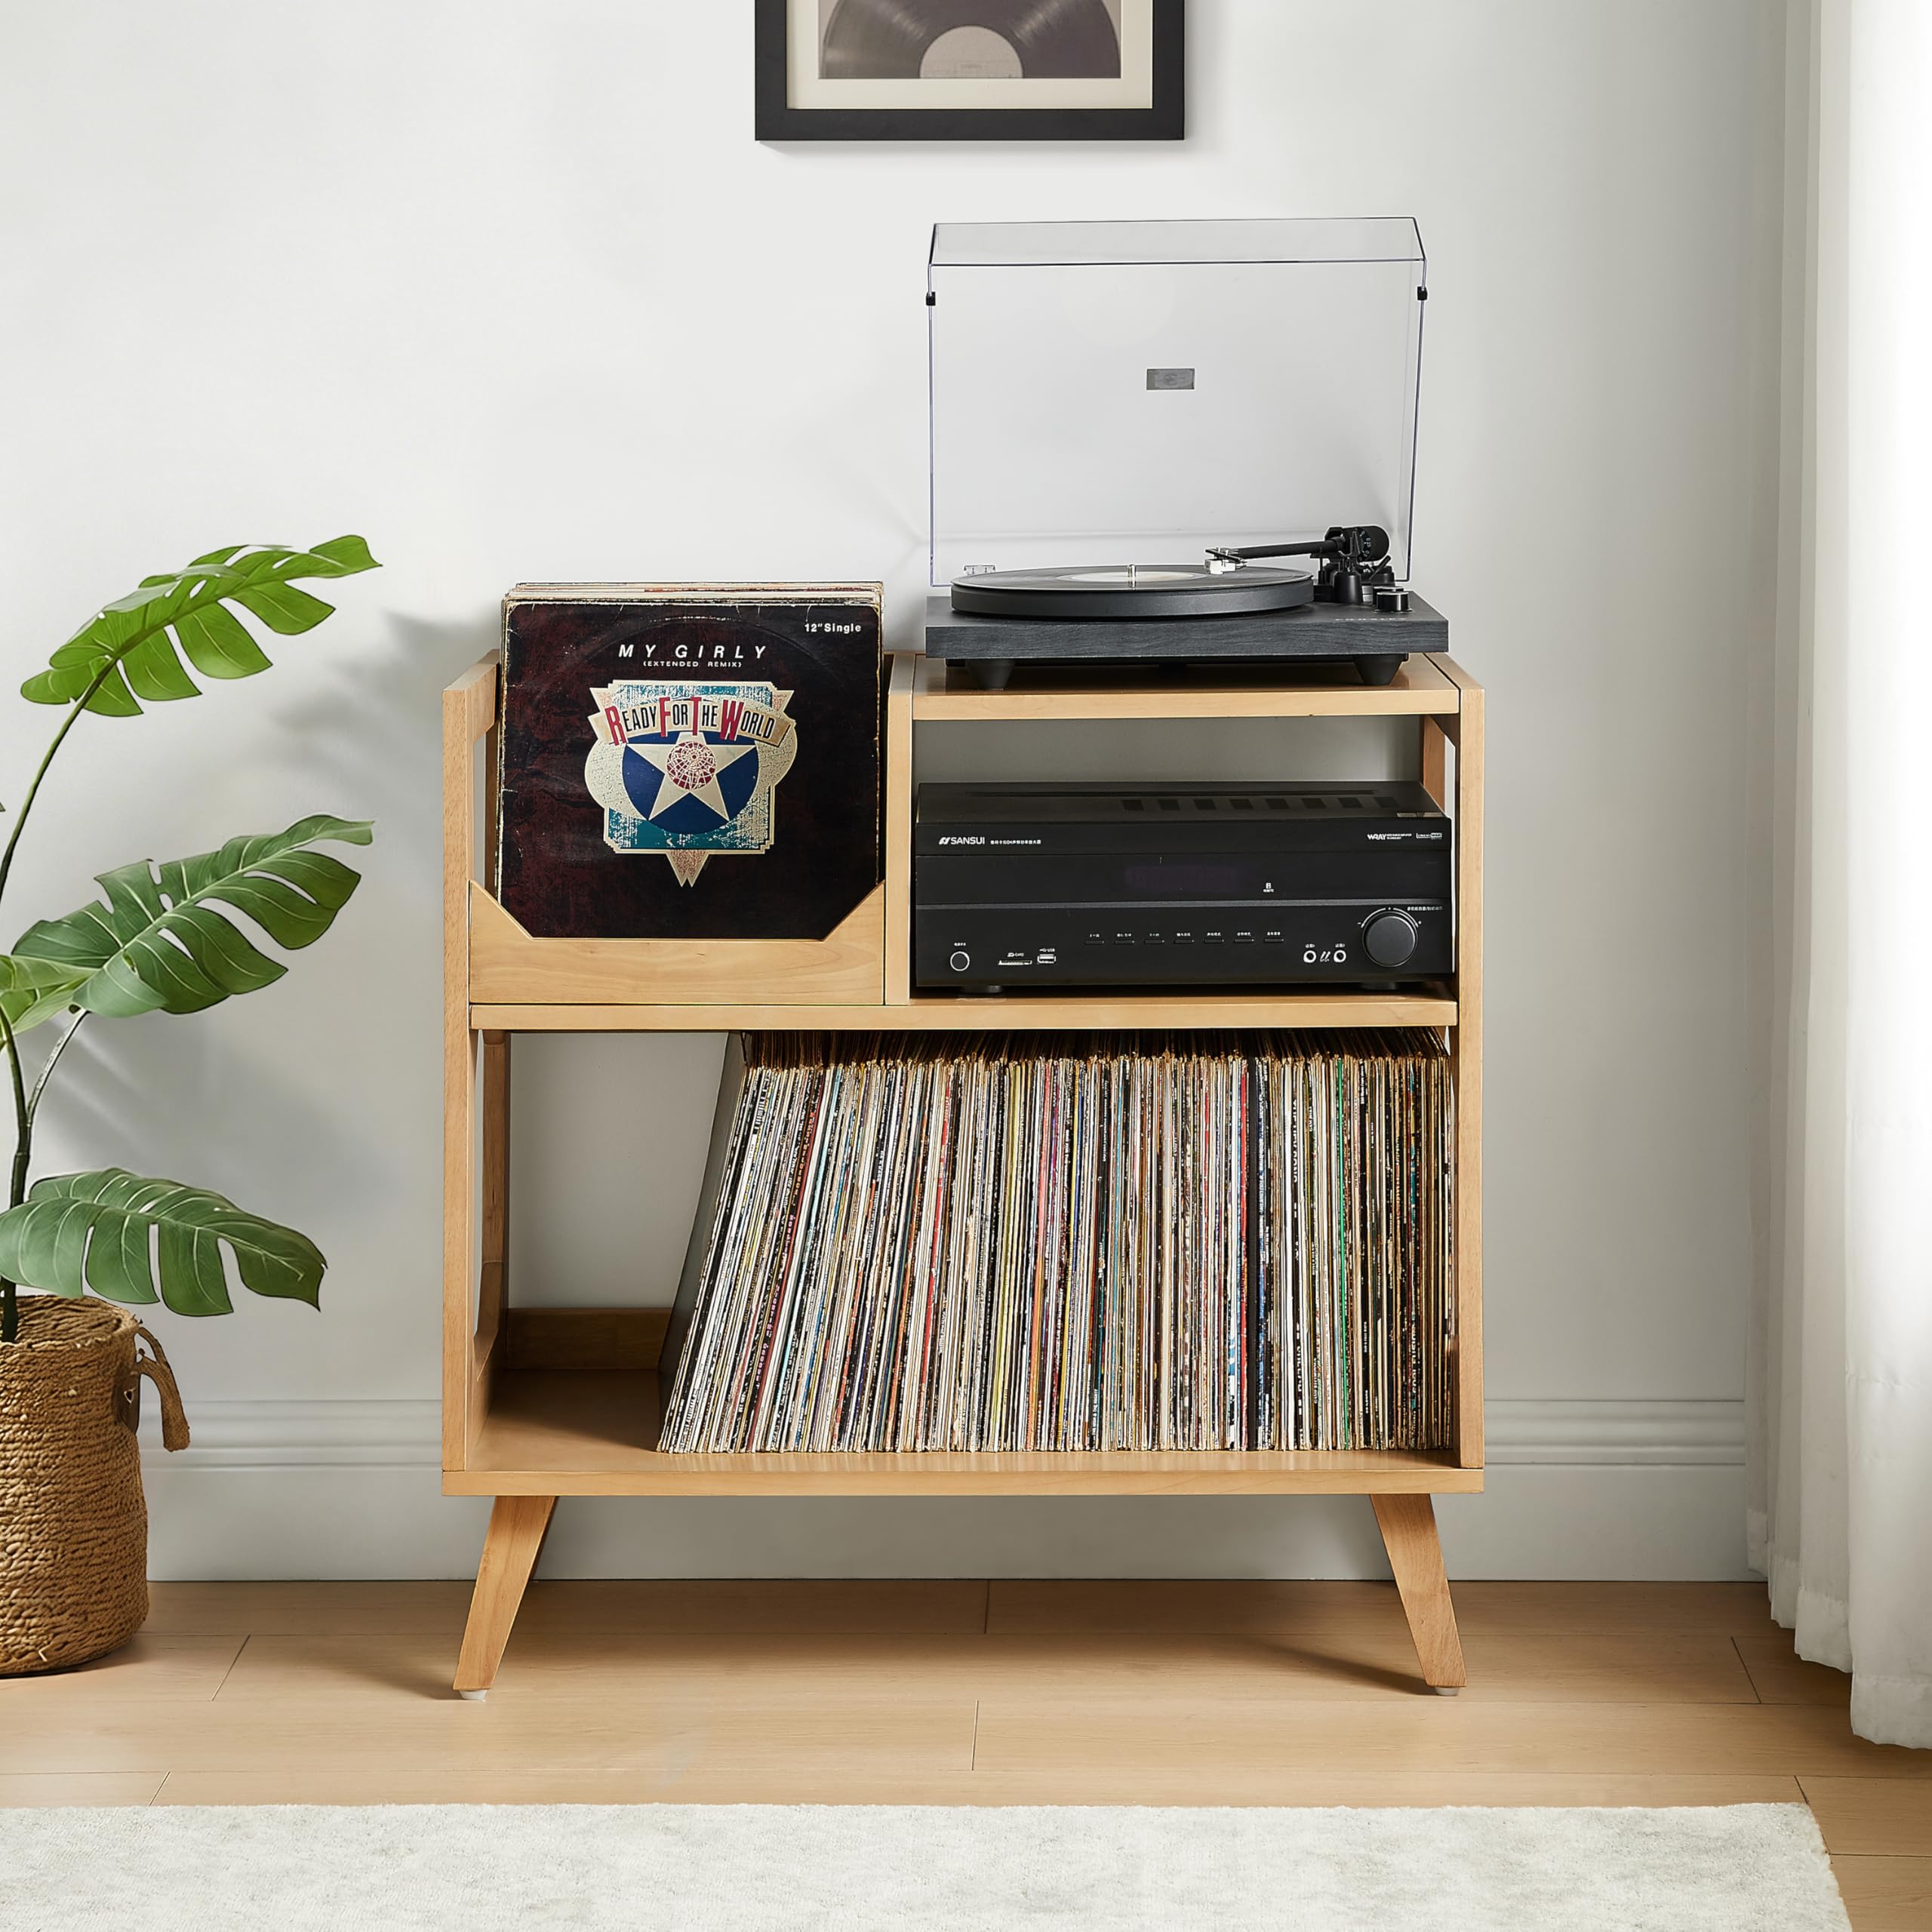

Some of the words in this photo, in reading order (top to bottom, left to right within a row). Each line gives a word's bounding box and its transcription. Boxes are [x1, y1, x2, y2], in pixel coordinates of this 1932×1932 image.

[618, 645, 657, 659] MY
[675, 645, 767, 660] GIRLY
[605, 705, 657, 746] READY
[659, 697, 688, 737] FOR
[690, 697, 718, 736] THE
[719, 700, 776, 741] WORLD
[950, 836, 986, 844] SANSUI
